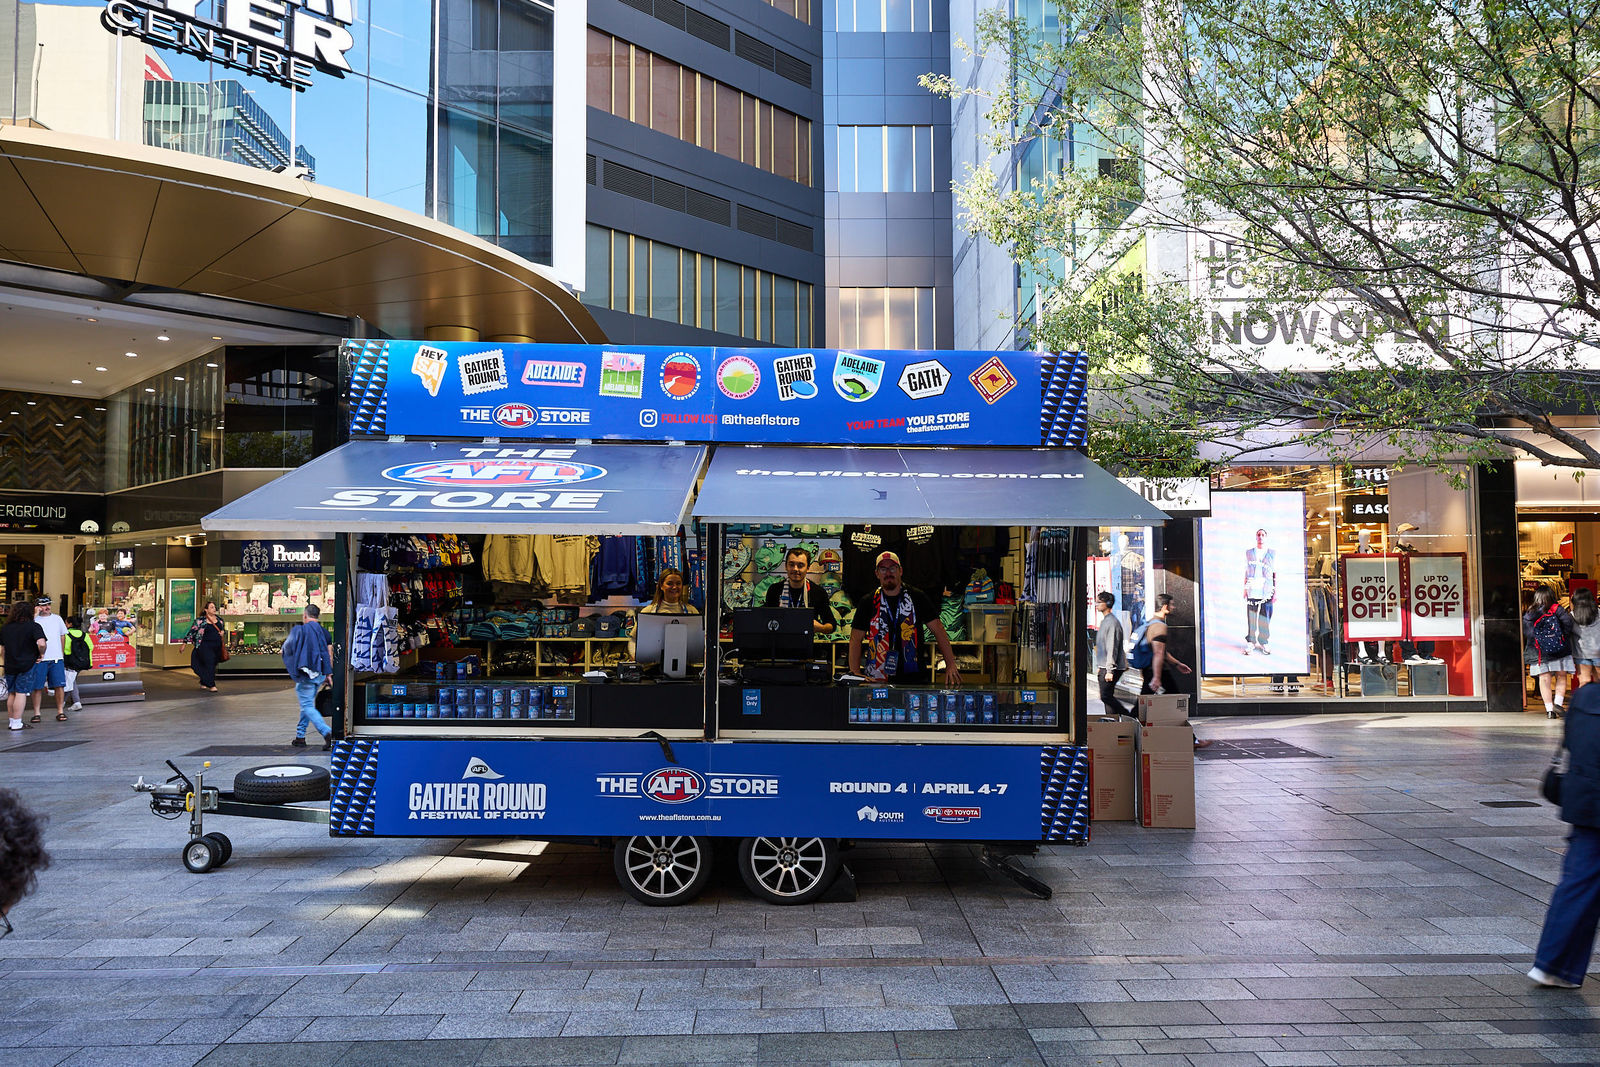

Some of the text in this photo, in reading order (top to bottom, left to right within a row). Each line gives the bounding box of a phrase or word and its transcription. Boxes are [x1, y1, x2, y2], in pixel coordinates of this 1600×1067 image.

[106, 0, 314, 87] CENTRE
[1211, 311, 1320, 345] NOW
[421, 348, 444, 361] HEY
[416, 358, 440, 380] SA
[464, 357, 500, 375] GATHER
[526, 363, 579, 381] ADELAIDE
[776, 356, 813, 373] GATHER
[841, 356, 879, 374] ADELAIDE
[467, 369, 501, 386] ROUND
[778, 369, 812, 386] ROUND
[907, 368, 942, 391] GATH
[780, 385, 794, 398] IT!
[460, 408, 590, 423] THE AFL STORE
[661, 414, 718, 424] FOLLOW US!
[722, 413, 800, 426] @theaflstore
[846, 412, 970, 431] YOUR TEAM YOUR STORE
[906, 422, 970, 434] theaflstore.com.au
[460, 448, 577, 459] THE
[398, 464, 585, 481] AFL
[735, 469, 1084, 479] theaflstore.com.au
[320, 489, 604, 509] STORE
[272, 544, 321, 562] Prouds
[1351, 585, 1397, 602] 60%
[1414, 584, 1460, 600] 60%
[596, 776, 779, 795] THE AFL STORE
[829, 782, 1008, 795] ROUND 4 APRIL 4-7
[409, 783, 547, 811] GATHER ROUND
[408, 811, 546, 820] A FESTIVAL OF FOOTY
